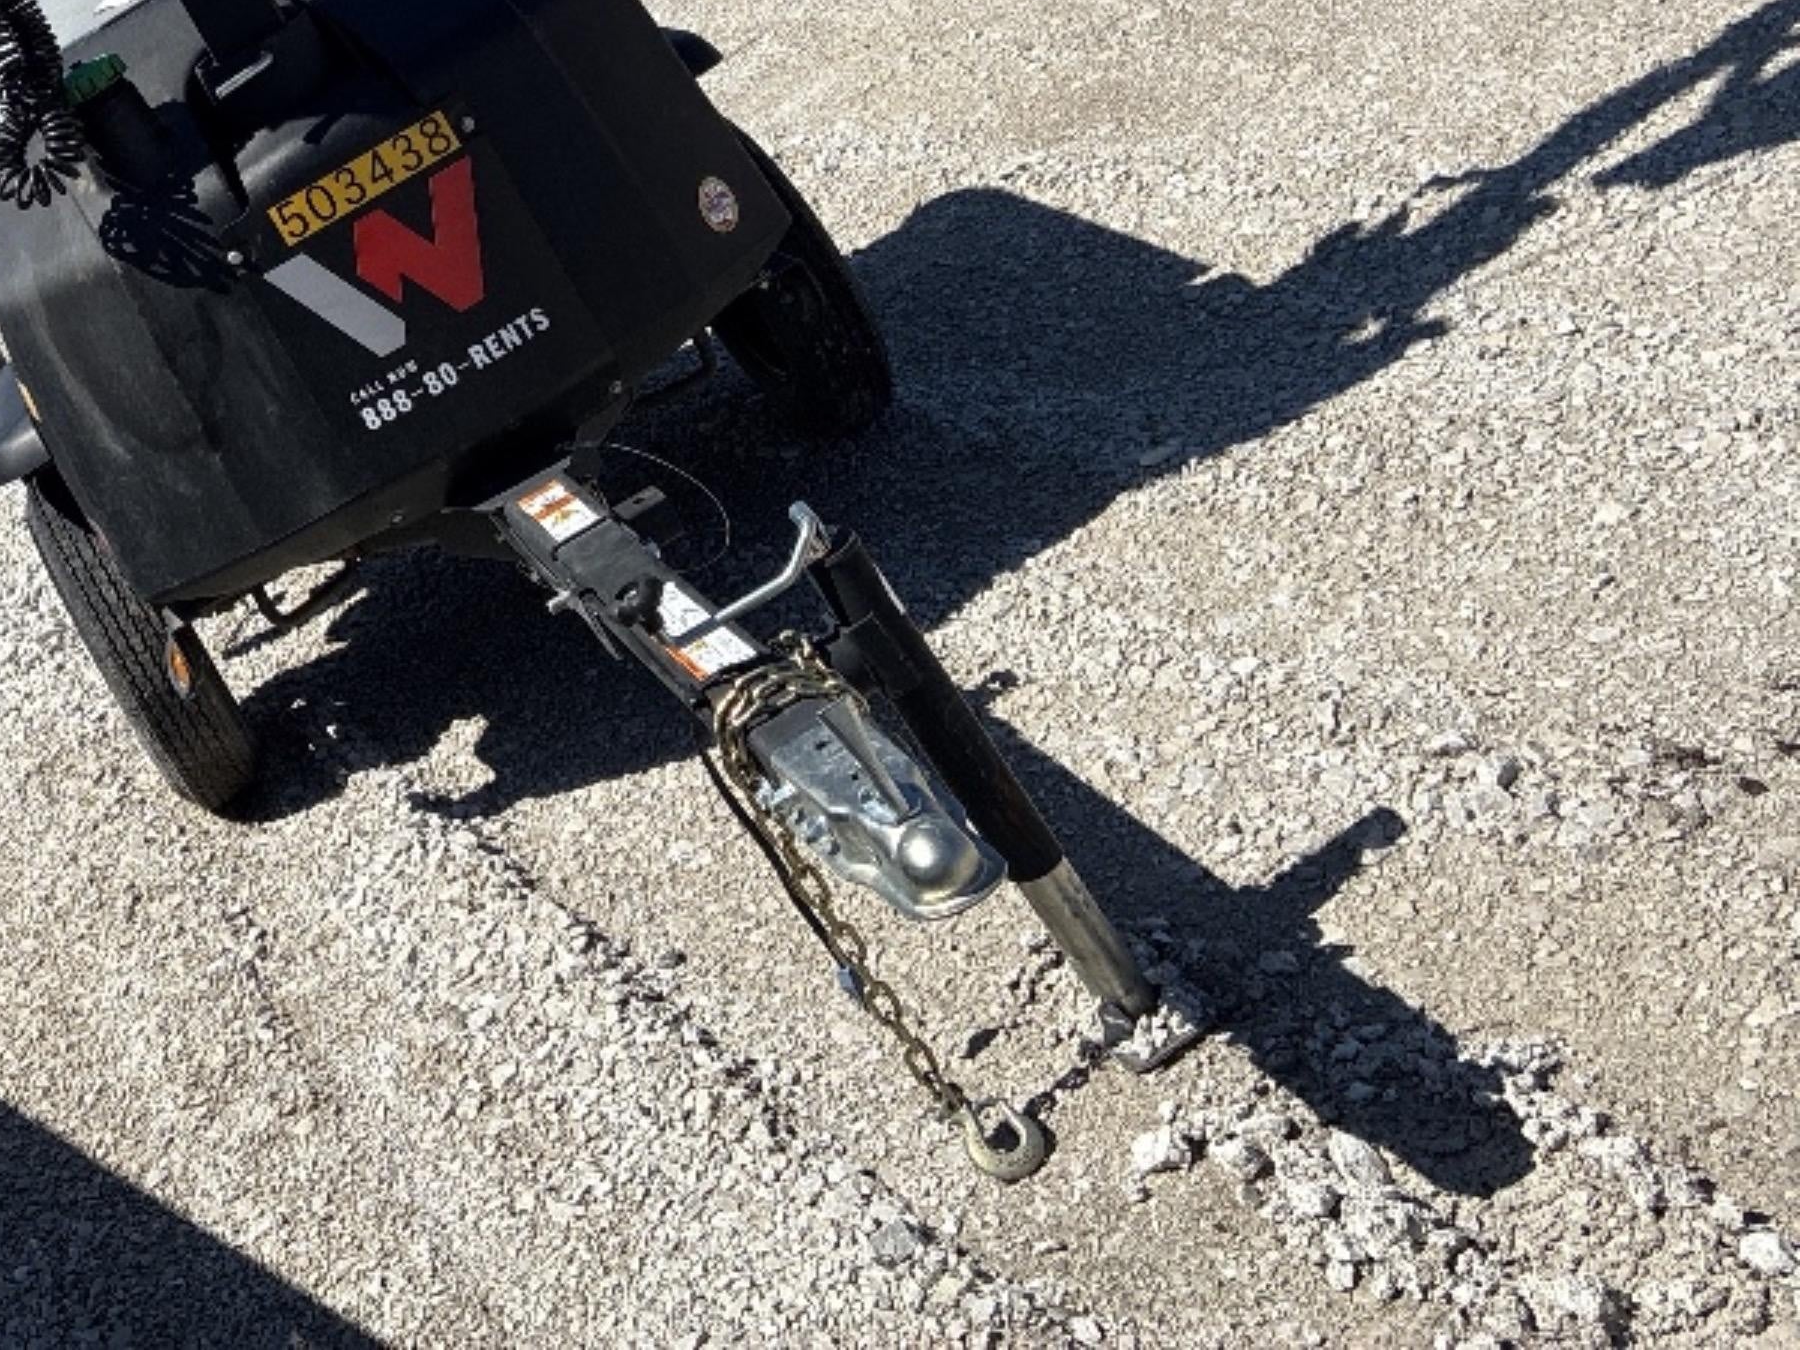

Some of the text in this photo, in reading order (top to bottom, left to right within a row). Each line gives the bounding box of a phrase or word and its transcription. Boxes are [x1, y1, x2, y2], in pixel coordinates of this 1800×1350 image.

[275, 117, 453, 239] 503438
[350, 380, 384, 405] CALL
[360, 307, 550, 430] 888-80-RENTS
